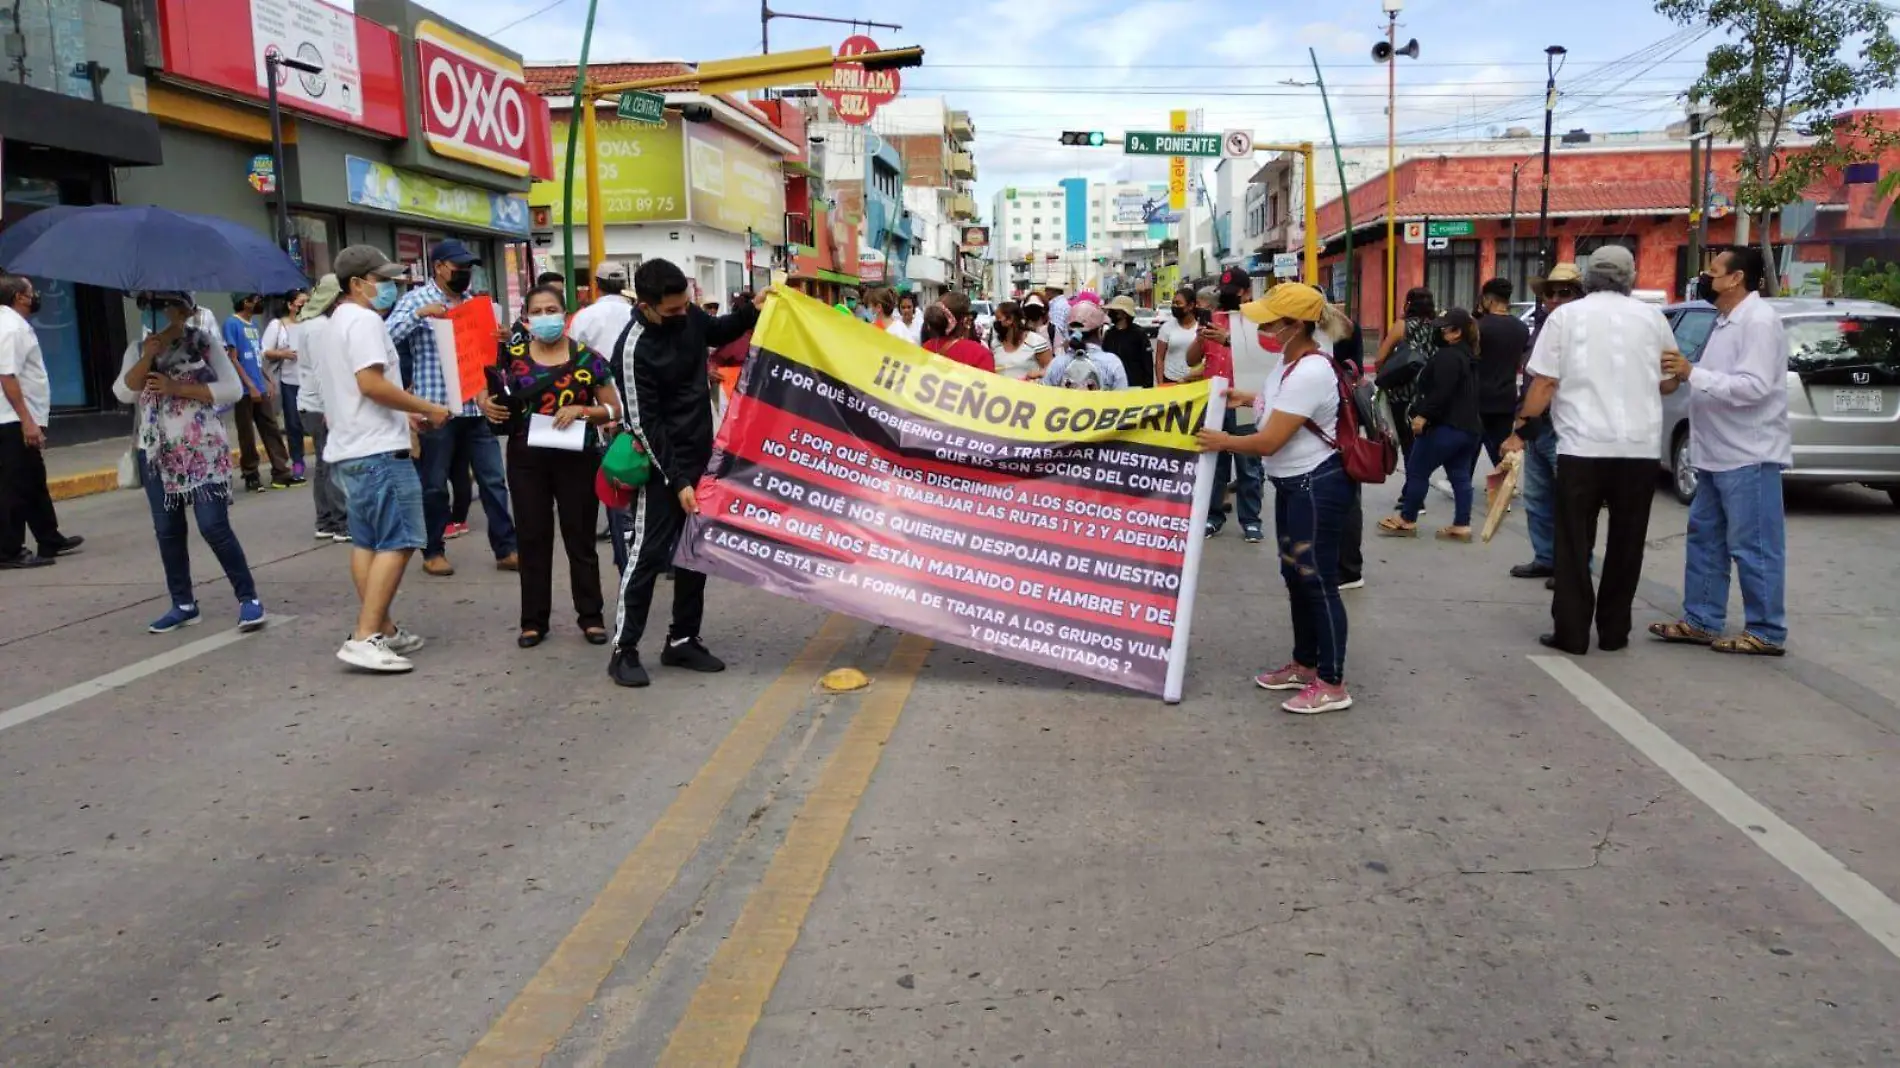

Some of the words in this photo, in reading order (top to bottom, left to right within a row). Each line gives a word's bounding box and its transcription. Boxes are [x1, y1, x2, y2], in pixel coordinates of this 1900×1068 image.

[428, 57, 525, 150] OXXO
[840, 94, 869, 116] SUIZA
[599, 141, 641, 157] OYAS
[1156, 137, 1217, 153] PONIENTE
[636, 198, 653, 212] 89
[656, 197, 674, 212] 75
[771, 365, 780, 377] ¿
[782, 368, 813, 391] POR
[817, 383, 845, 404] QUÉ
[847, 397, 865, 412] SU
[868, 405, 944, 441] GOBIERNO
[946, 435, 966, 447] LE
[968, 439, 995, 454] DIO
[998, 447, 1008, 456] A
[1013, 447, 1094, 460] TRABAJAR
[1098, 449, 1179, 473] NUESTRAS
[1183, 462, 1196, 475] R
[914, 373, 1036, 431] SEÑOR
[762, 439, 786, 457] NO
[788, 450, 892, 493] DEJÁNDONOS
[895, 484, 973, 513] TRABAJAR
[976, 502, 1005, 520] LAS
[1009, 509, 1059, 530] RUTAS
[1062, 519, 1069, 532] 1
[1073, 521, 1084, 534] Y
[1085, 524, 1096, 537] 2
[1100, 526, 1112, 539] Y
[789, 429, 798, 442] ¿
[801, 432, 833, 455] POR
[836, 445, 869, 468] QUÉ
[870, 457, 890, 474] SE
[891, 466, 923, 483] NOS
[927, 471, 1014, 501] DISCRIMINÓ
[1017, 492, 1028, 503] A
[1032, 494, 1061, 510] LOS
[1065, 501, 1122, 521] SOCIOS
[1126, 511, 1190, 532] CONCES
[935, 448, 967, 464] QUE
[971, 456, 993, 468] NO
[998, 462, 1031, 473] SON
[1034, 462, 1092, 480] SOCIOS
[1095, 470, 1123, 486] DEL
[729, 499, 740, 514] ¿
[743, 503, 781, 528] POR
[785, 517, 824, 541] QUÉ
[826, 531, 864, 554] NOS
[867, 546, 923, 571] ESTÁN
[927, 559, 1014, 592] MATANDO
[1019, 580, 1046, 598] DE
[1047, 586, 1122, 616] HAMBRE
[1128, 603, 1141, 618] Y
[752, 473, 763, 486] ¿
[767, 476, 804, 501] POR
[807, 491, 845, 514] QUÉ
[848, 504, 885, 527] NOS
[890, 516, 967, 548] QUIEREN
[970, 535, 1061, 567] DESPOJAR
[1065, 555, 1090, 573] DE
[1094, 560, 1179, 591] NUESTRO
[704, 526, 713, 541] ¿
[716, 532, 771, 558] ACASO
[773, 550, 811, 572] ESTA
[816, 563, 835, 578] ES
[838, 570, 858, 587] LA
[862, 577, 916, 602] FORMA
[921, 592, 943, 609] DE
[947, 598, 1006, 625] TRATAR
[1008, 615, 1020, 628] A
[1023, 618, 1054, 636] LOS
[1058, 625, 1123, 651] GRUPOS
[1128, 641, 1171, 662] VULN
[969, 625, 982, 638] Y
[983, 629, 1119, 671] DISCAPACITADOS
[1123, 661, 1132, 673] ?
